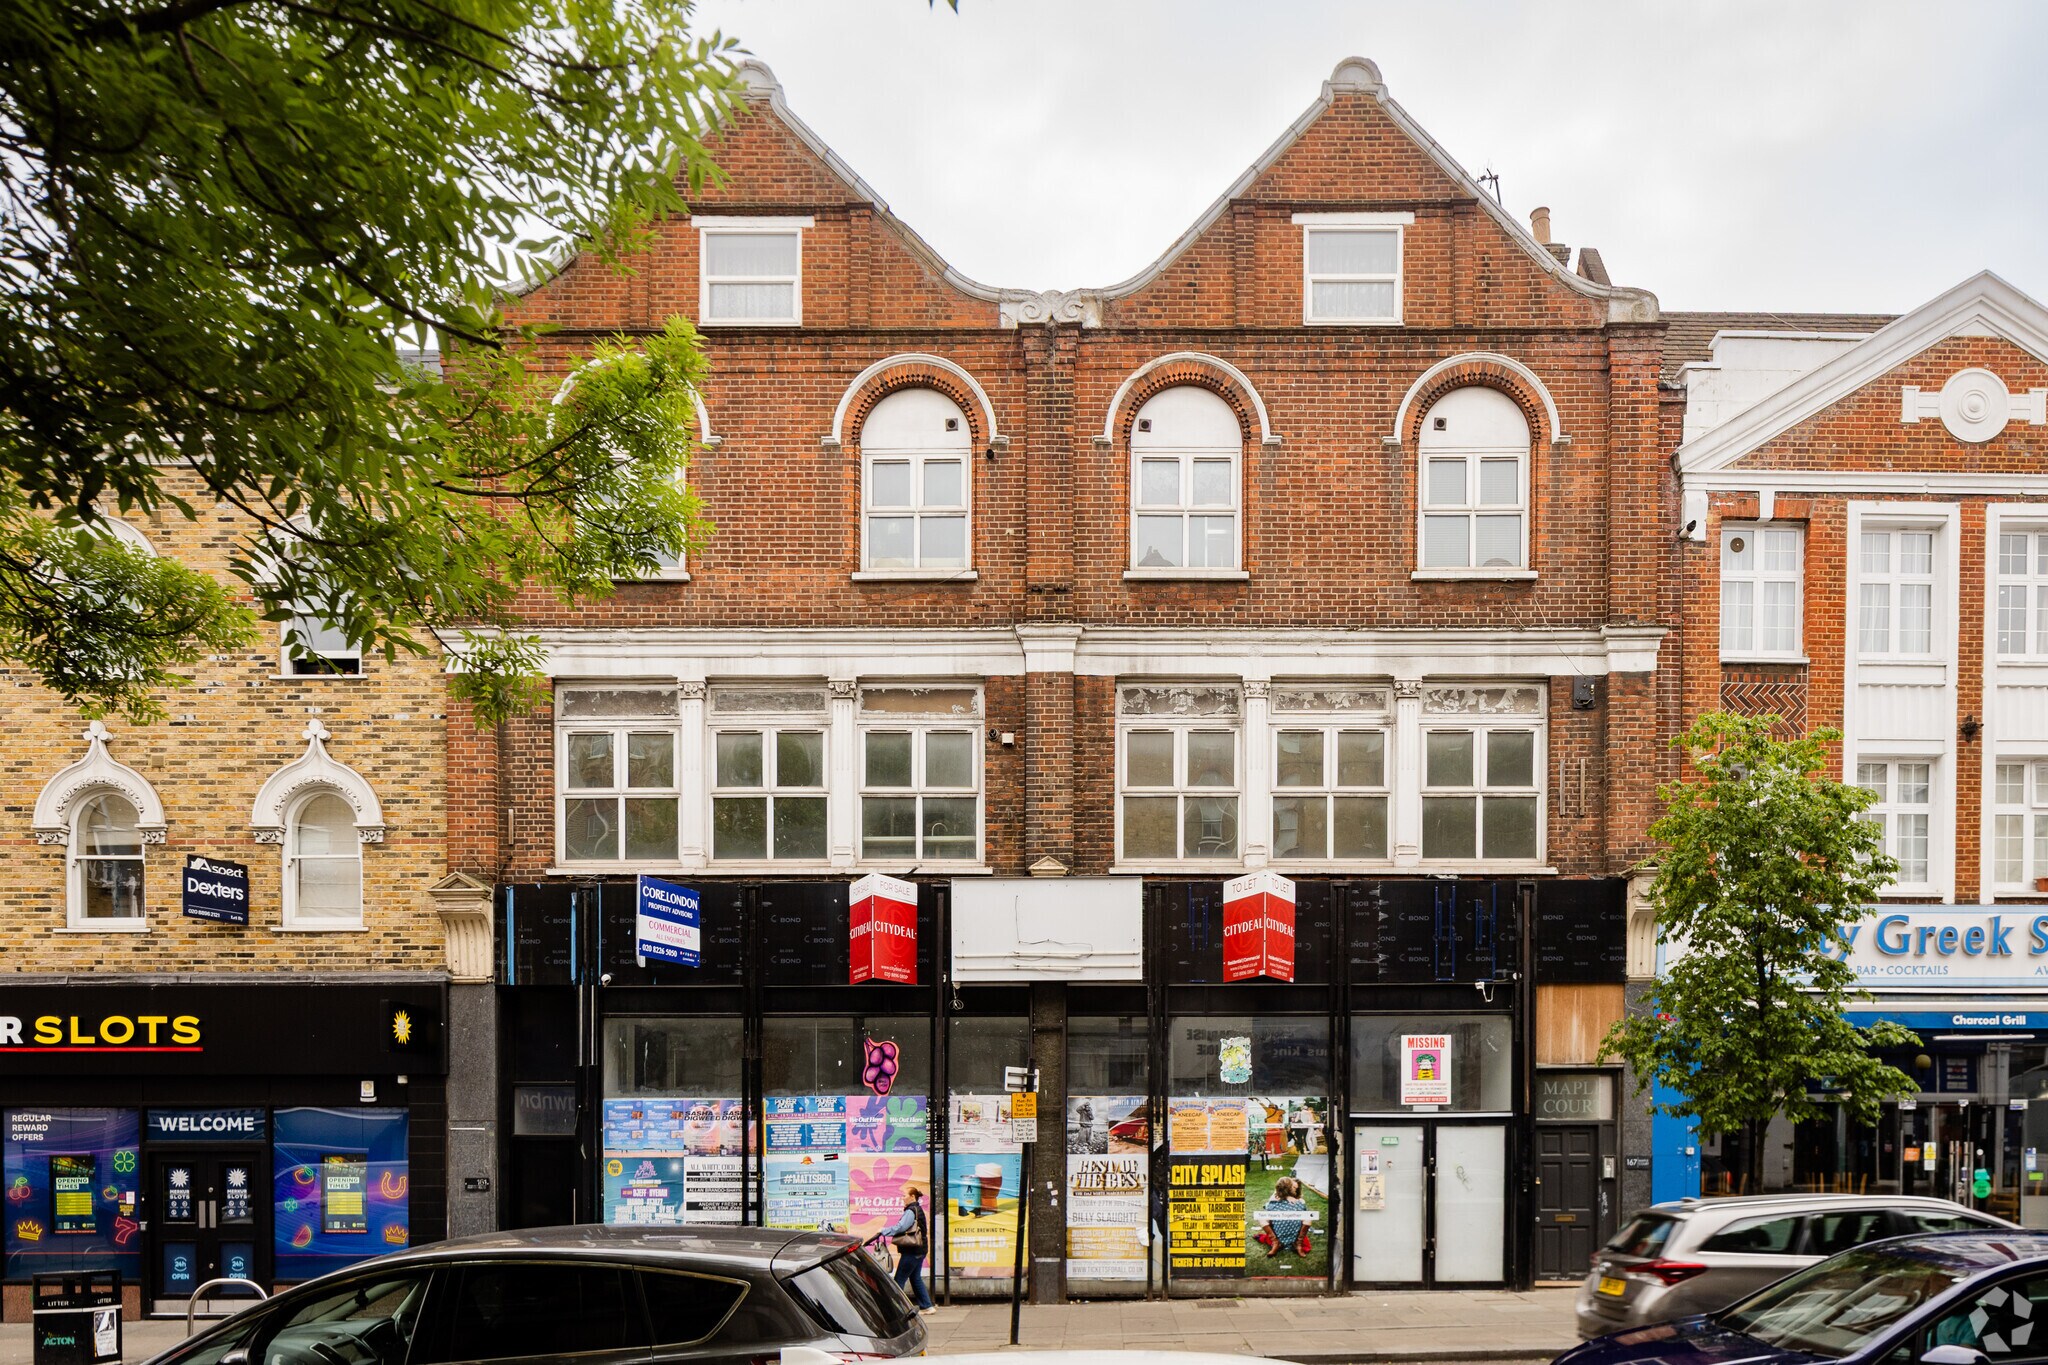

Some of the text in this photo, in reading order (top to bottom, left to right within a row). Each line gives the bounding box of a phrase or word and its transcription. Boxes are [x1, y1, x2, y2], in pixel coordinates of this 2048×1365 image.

[188, 877, 244, 900] Dexters
[880, 881, 910, 896] FOR SALE
[1233, 878, 1257, 893] TO LET
[1272, 878, 1289, 893] TO LET
[648, 902, 693, 919] PROPERTY ADVISORS
[649, 921, 691, 938] COMMERCIAL
[850, 921, 872, 939] CITYDEAL
[875, 921, 915, 939] CITYDEAL
[1224, 918, 1263, 937] CITYDEAL
[1266, 918, 1294, 937] CITYDEAL
[665, 936, 685, 944] ENQUIRIES
[1877, 915, 2015, 955] Greek
[642, 944, 652, 952] 020
[666, 949, 677, 957] 5050
[1857, 966, 1948, 975] BAR COCKTAILS
[1953, 1015, 2026, 1025] Charcoal Grill
[0, 1015, 200, 1044] R SLOTS
[1408, 1037, 1445, 1048] MISSING
[160, 1117, 254, 1131] WELCOME
[1120, 1160, 1138, 1173] OF
[784, 1174, 832, 1184] #MATTSBBQ
[1172, 1165, 1198, 1185] CITY
[854, 1197, 872, 1206] We
[873, 1197, 893, 1206] Out
[1173, 1204, 1201, 1213] POPCAAN
[1209, 1204, 1231, 1213] TARRUS
[1073, 1212, 1095, 1222] BILLY
[953, 1251, 996, 1262] LONDON
[1172, 1258, 1192, 1267] TICKETS
[44, 1337, 74, 1345] ACTON
